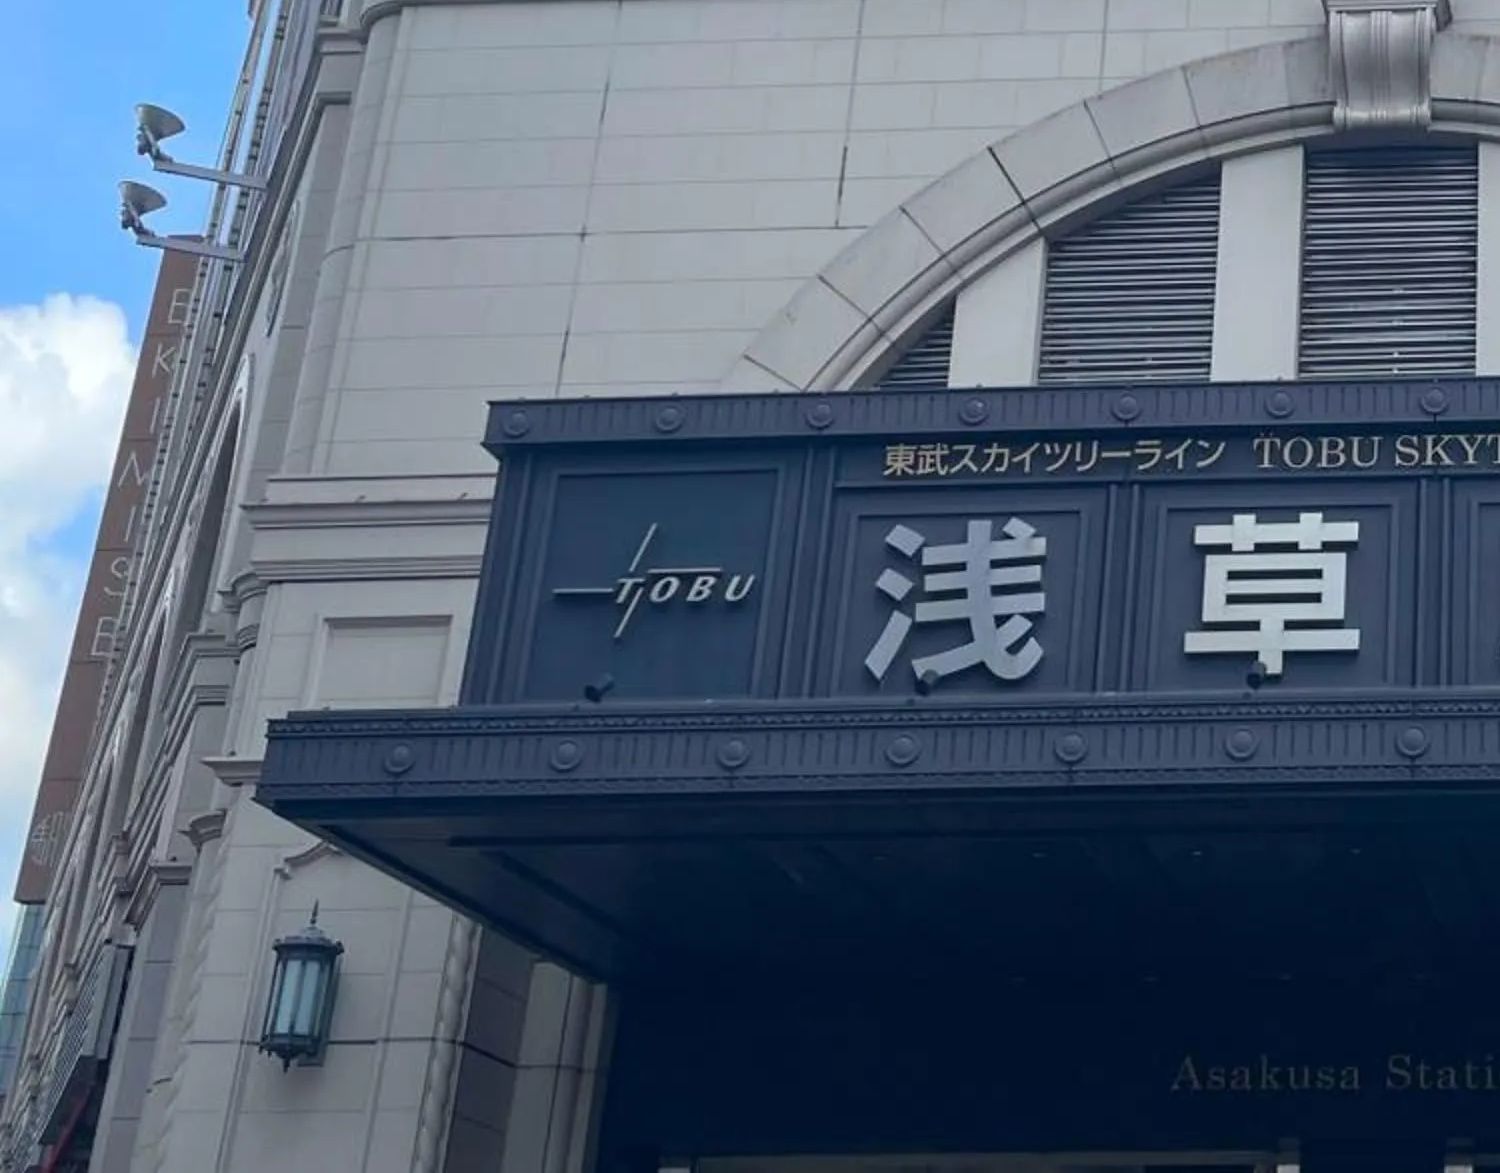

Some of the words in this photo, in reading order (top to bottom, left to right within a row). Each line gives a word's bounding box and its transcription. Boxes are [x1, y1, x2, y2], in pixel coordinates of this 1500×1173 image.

[883, 438, 1226, 477] 東武スカイツリーライン
[1254, 435, 1381, 470] TOBU
[616, 574, 755, 604] TOBU
[1171, 1055, 1361, 1091] Asakusa
